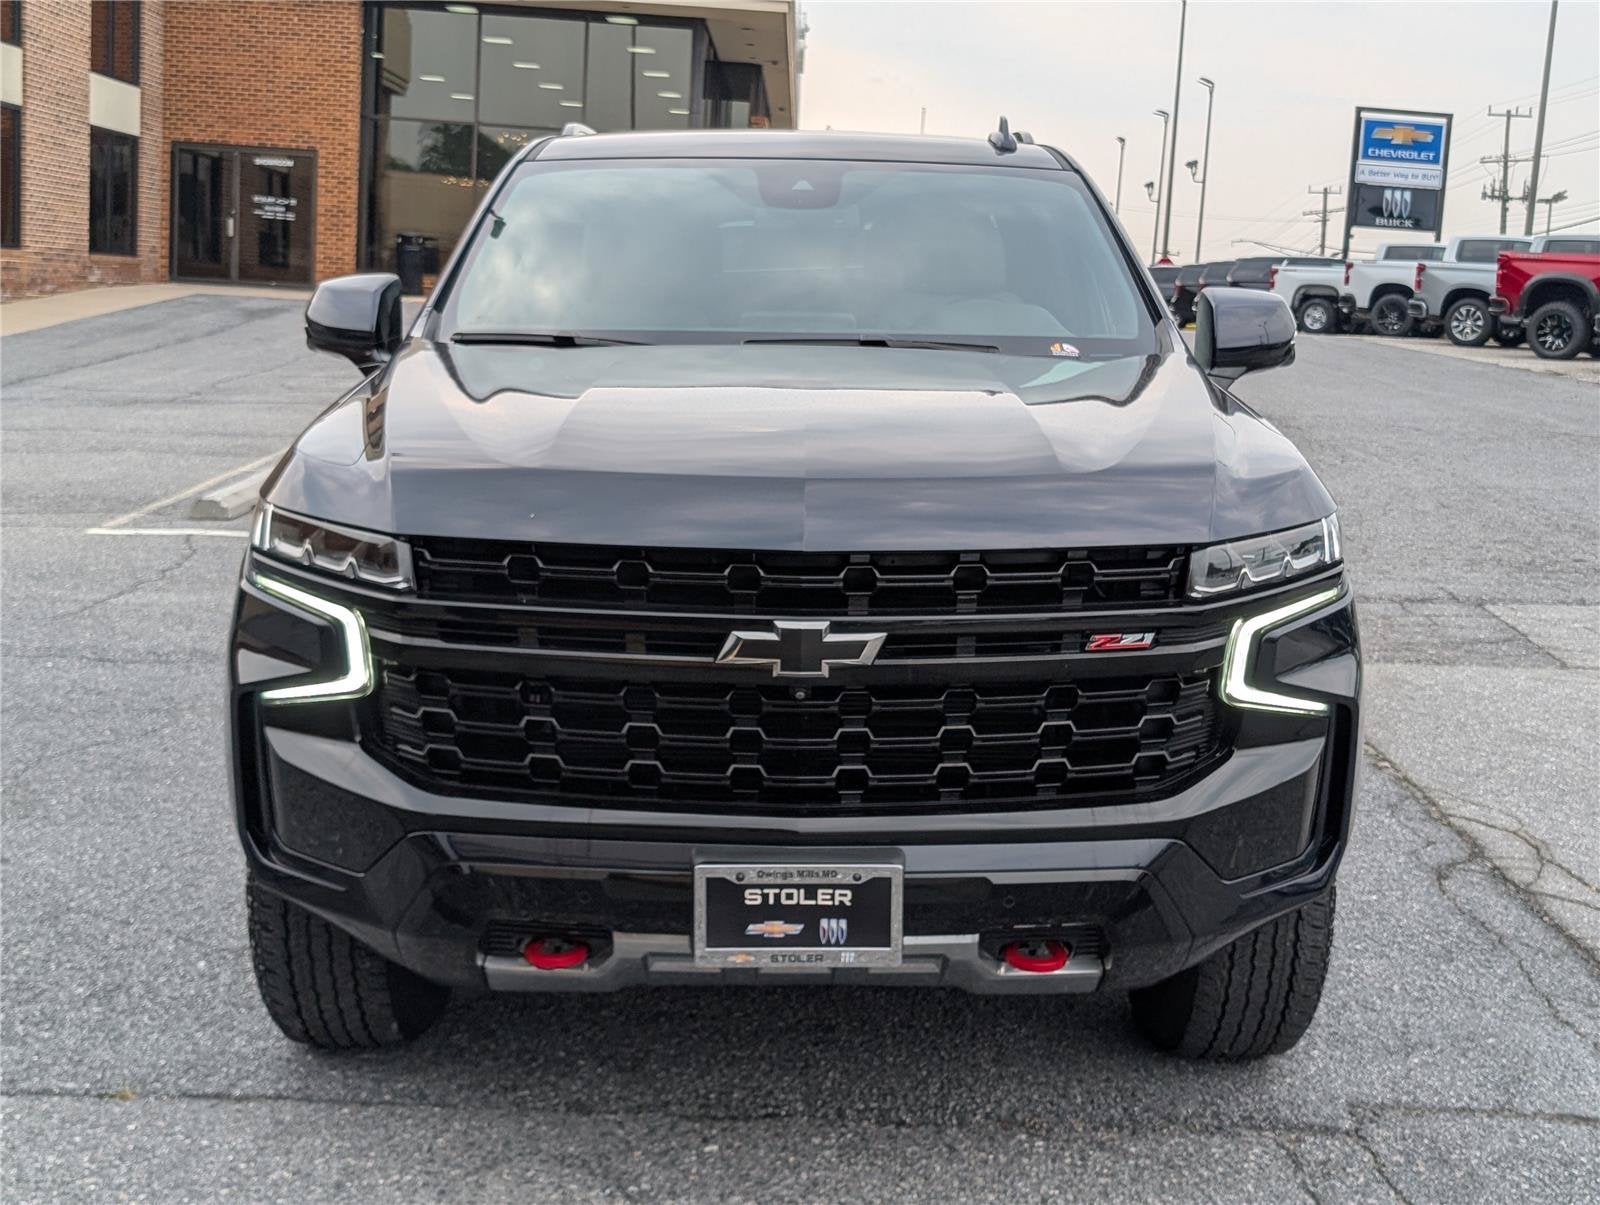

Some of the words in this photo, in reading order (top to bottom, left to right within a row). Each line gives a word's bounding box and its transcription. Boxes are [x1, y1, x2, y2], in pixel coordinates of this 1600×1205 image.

[1367, 148, 1436, 160] CHEVROLET
[1368, 169, 1390, 177] Better
[1393, 171, 1409, 180] Way
[1375, 217, 1414, 228] BUICK
[757, 870, 794, 880] Owings
[744, 888, 852, 906] STOLER
[770, 954, 824, 963] STOLER
